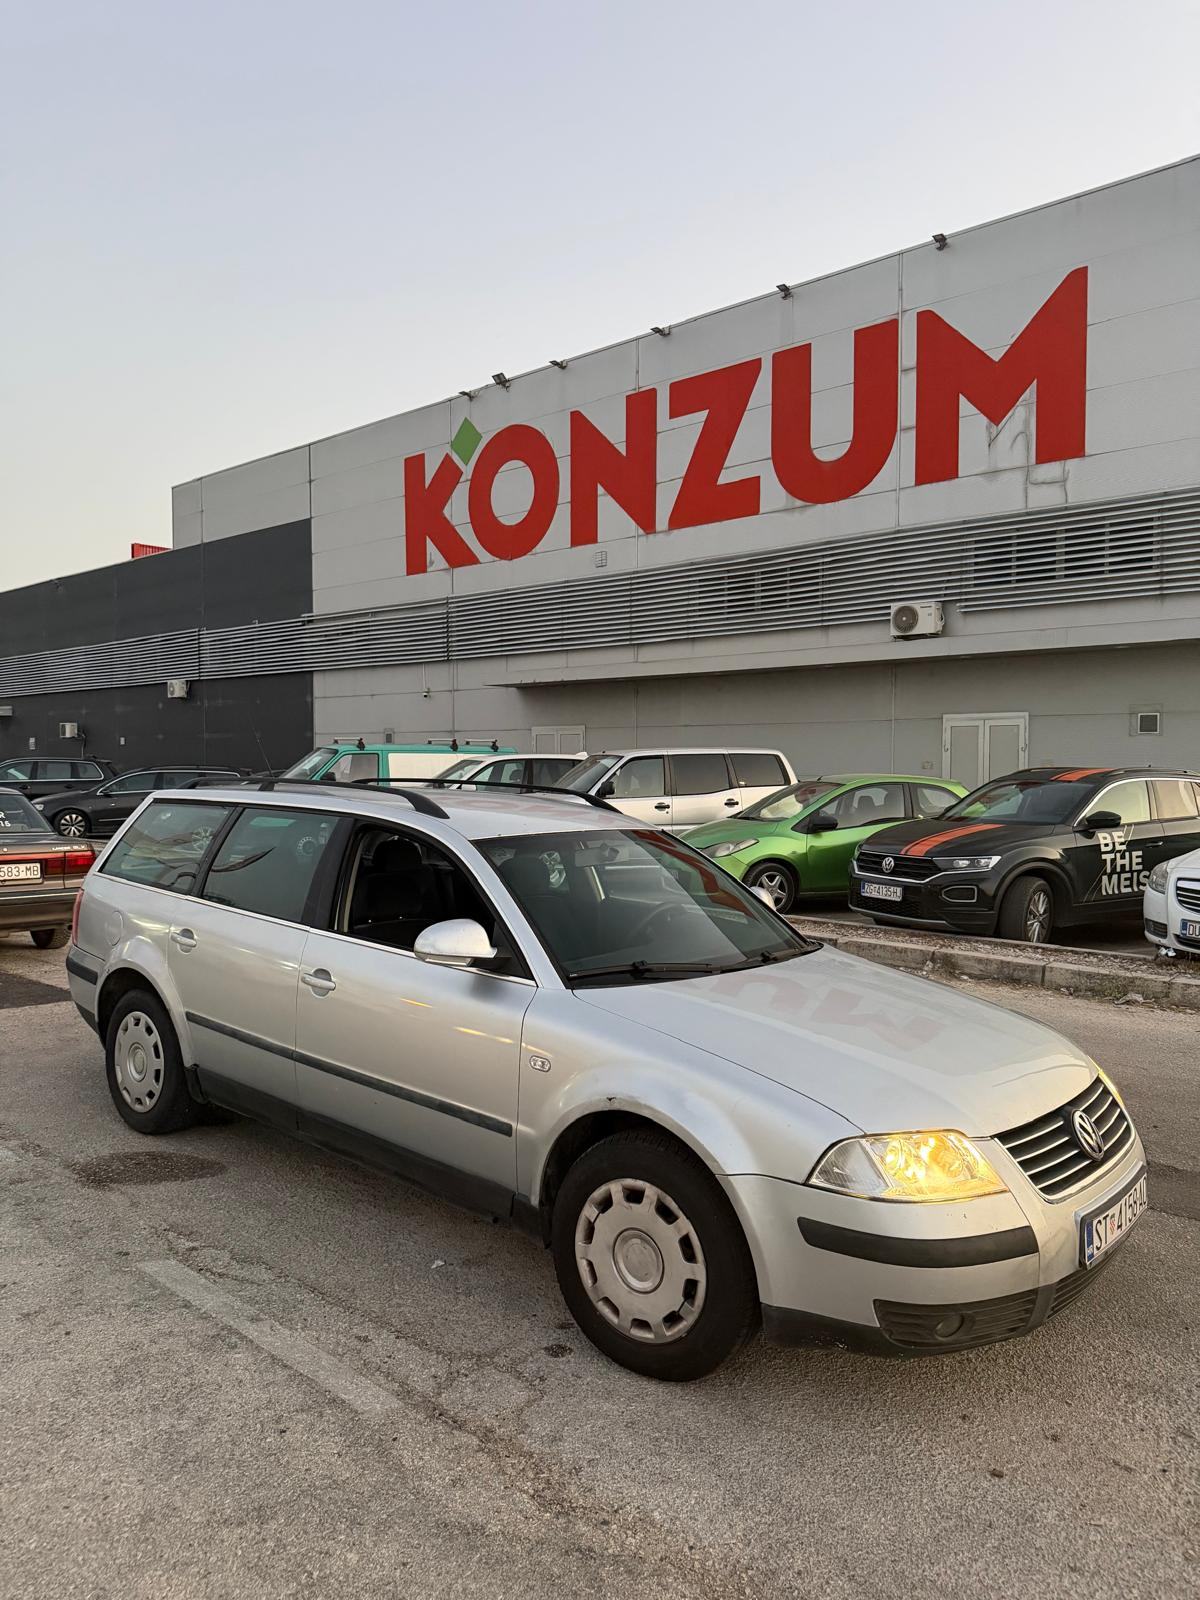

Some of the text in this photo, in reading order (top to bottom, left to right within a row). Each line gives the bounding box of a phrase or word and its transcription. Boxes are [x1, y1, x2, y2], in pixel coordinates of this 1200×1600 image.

[405, 267, 1087, 575] KONZUM
[1098, 831, 1127, 852] BE
[1101, 850, 1143, 873] THE
[1095, 1213, 1109, 1251] ST
